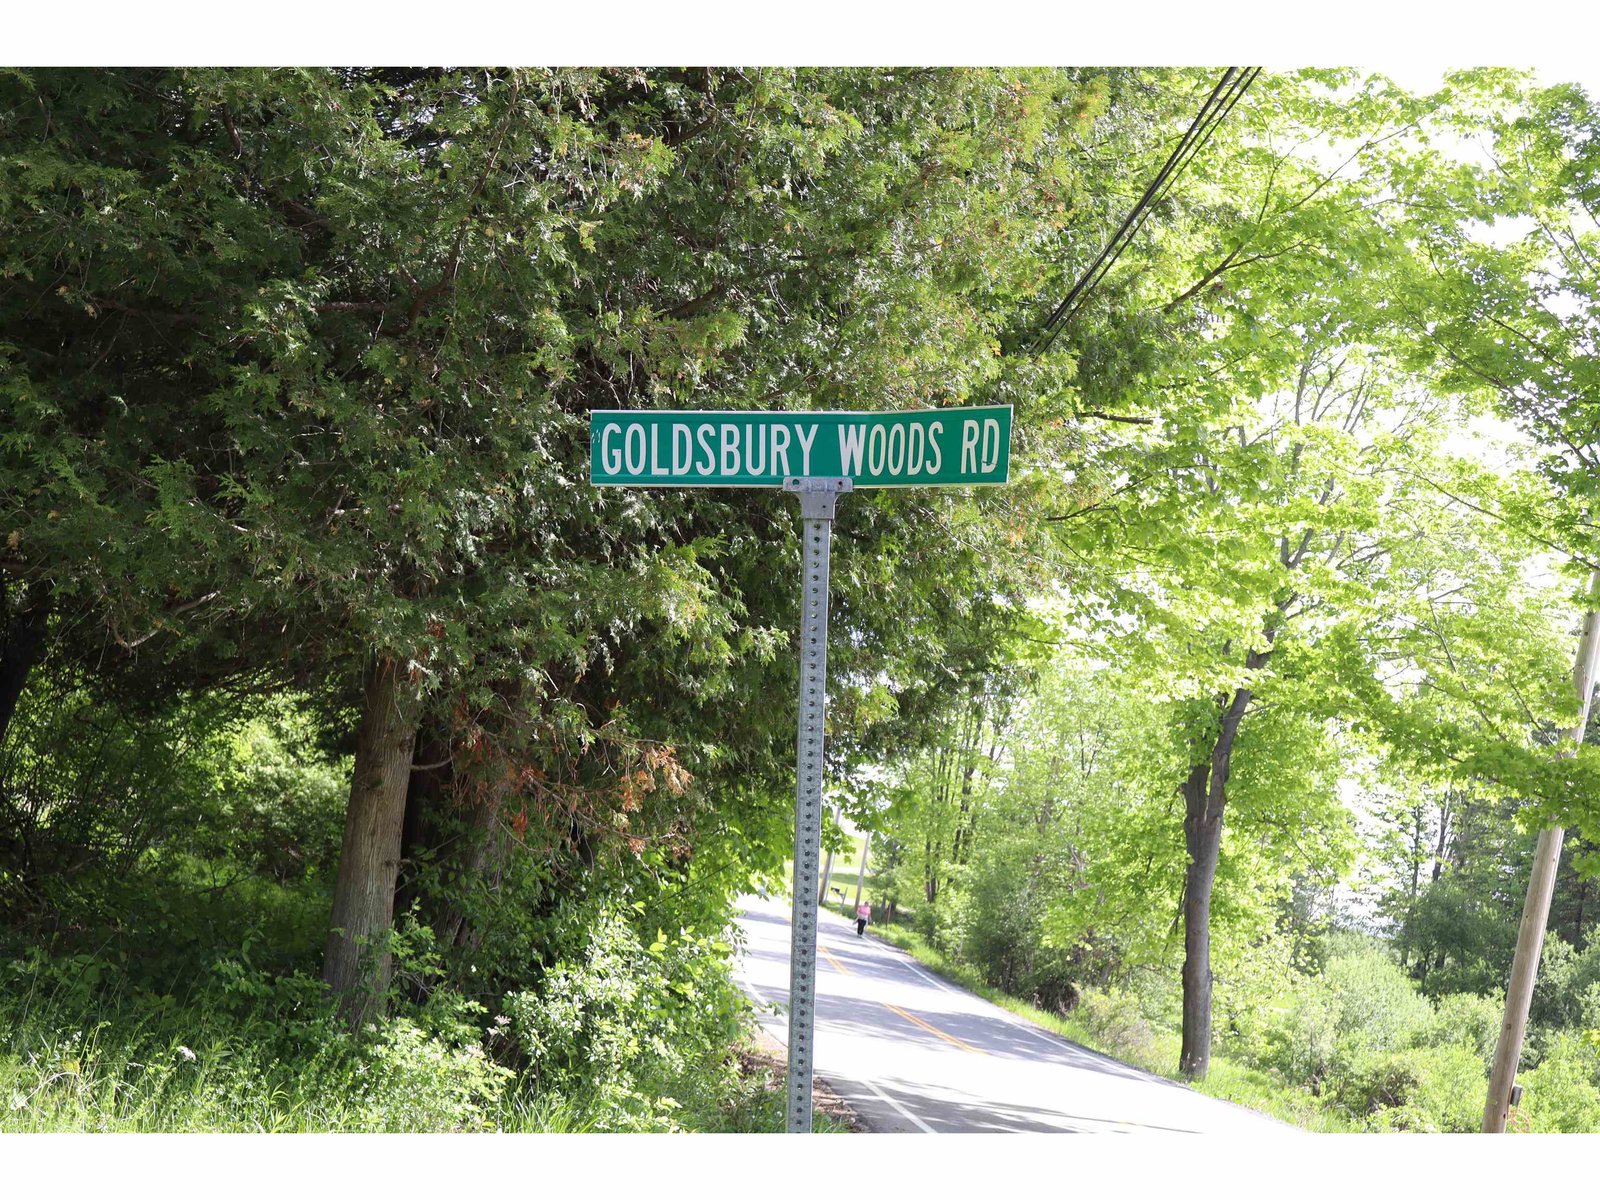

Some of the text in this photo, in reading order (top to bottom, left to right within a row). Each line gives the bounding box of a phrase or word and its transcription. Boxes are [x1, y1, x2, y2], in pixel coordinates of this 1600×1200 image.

[601, 418, 1000, 477] GOLDSBURY WOODS RD
